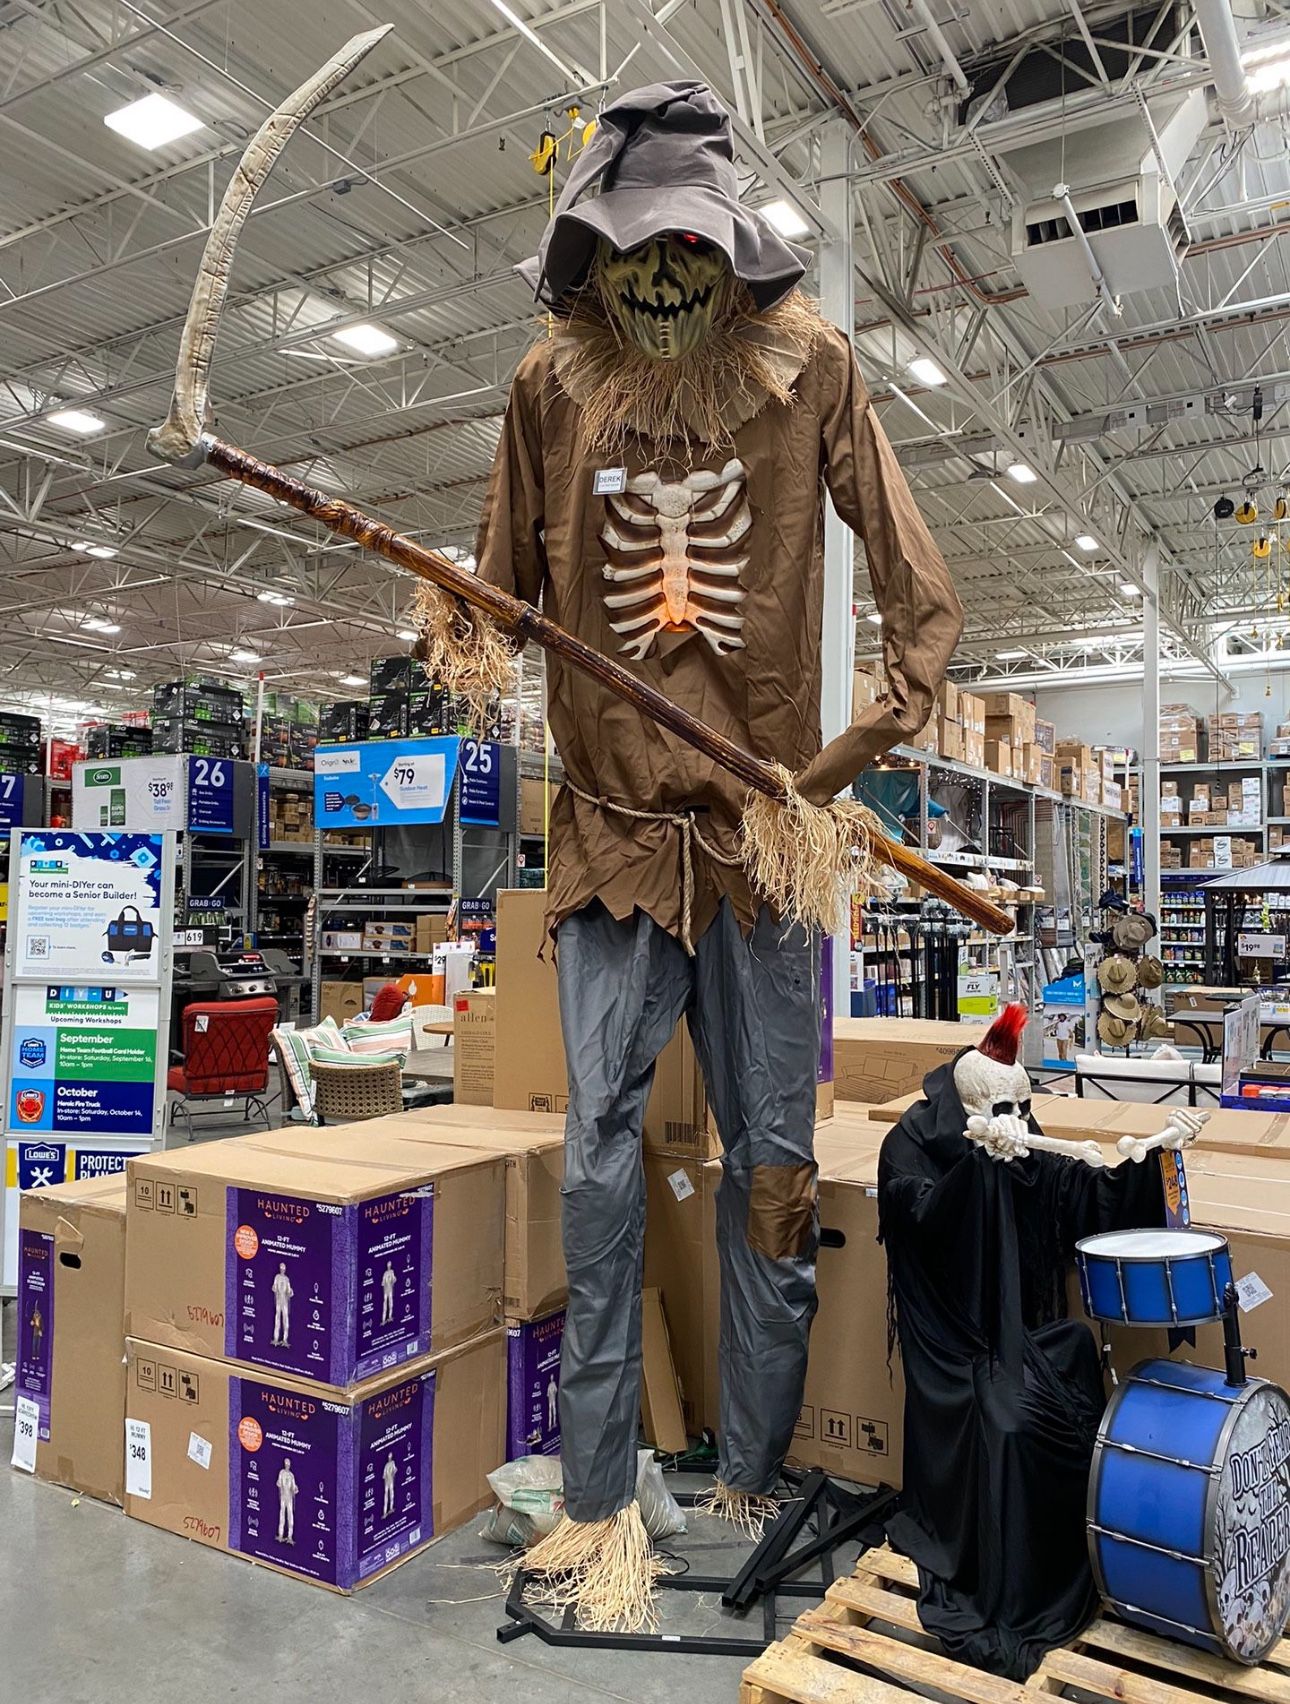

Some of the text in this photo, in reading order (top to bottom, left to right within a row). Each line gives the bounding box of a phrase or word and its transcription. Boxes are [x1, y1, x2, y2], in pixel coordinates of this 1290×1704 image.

[599, 475, 621, 483] DEREK
[465, 741, 492, 774] 25
[195, 759, 225, 787] 26
[393, 767, 415, 785] $79
[2, 775, 16, 798] 7
[30, 880, 48, 888] Your
[50, 880, 95, 889] mini-DIYer
[28, 890, 63, 898] become
[73, 890, 101, 899] Senior
[103, 891, 137, 899] Builder!
[190, 899, 209, 907] GRAB
[462, 901, 490, 910] GRAB GO
[186, 932, 203, 942] 619
[50, 1016, 122, 1024] Upcoming Workshops
[460, 1012, 487, 1023] allen
[60, 1032, 114, 1044] September
[84, 1054, 112, 1062] Saturday,
[57, 1086, 98, 1097] October
[81, 1108, 109, 1116] Saturday,
[109, 1108, 134, 1116] October
[28, 1150, 56, 1159] LOWE'S
[140, 1186, 150, 1195] 10
[257, 1198, 343, 1217] HAUNTED #5279607
[364, 1195, 416, 1218] HAUNTED
[272, 1214, 295, 1223] LIVING
[379, 1210, 402, 1222] LIVING
[261, 1239, 286, 1249] ANIMATED
[286, 1243, 306, 1253] MUMMY
[368, 1240, 393, 1254] ANIMATED
[392, 1234, 411, 1246] MUMMY
[142, 1365, 152, 1376] 10
[261, 1391, 350, 1416] HAUNTED #5279607
[368, 1383, 418, 1415] HAUNTED
[276, 1407, 301, 1419] LIVING
[18, 1420, 33, 1438] $398
[265, 1432, 291, 1445] ANIMATED
[290, 1439, 312, 1451] MUMMY
[370, 1432, 395, 1450] ANIMATED
[394, 1422, 412, 1436] MUMMY
[129, 1443, 146, 1461] $348
[1258, 1476, 1279, 1520] THE
[1233, 1501, 1290, 1597] REAPER
